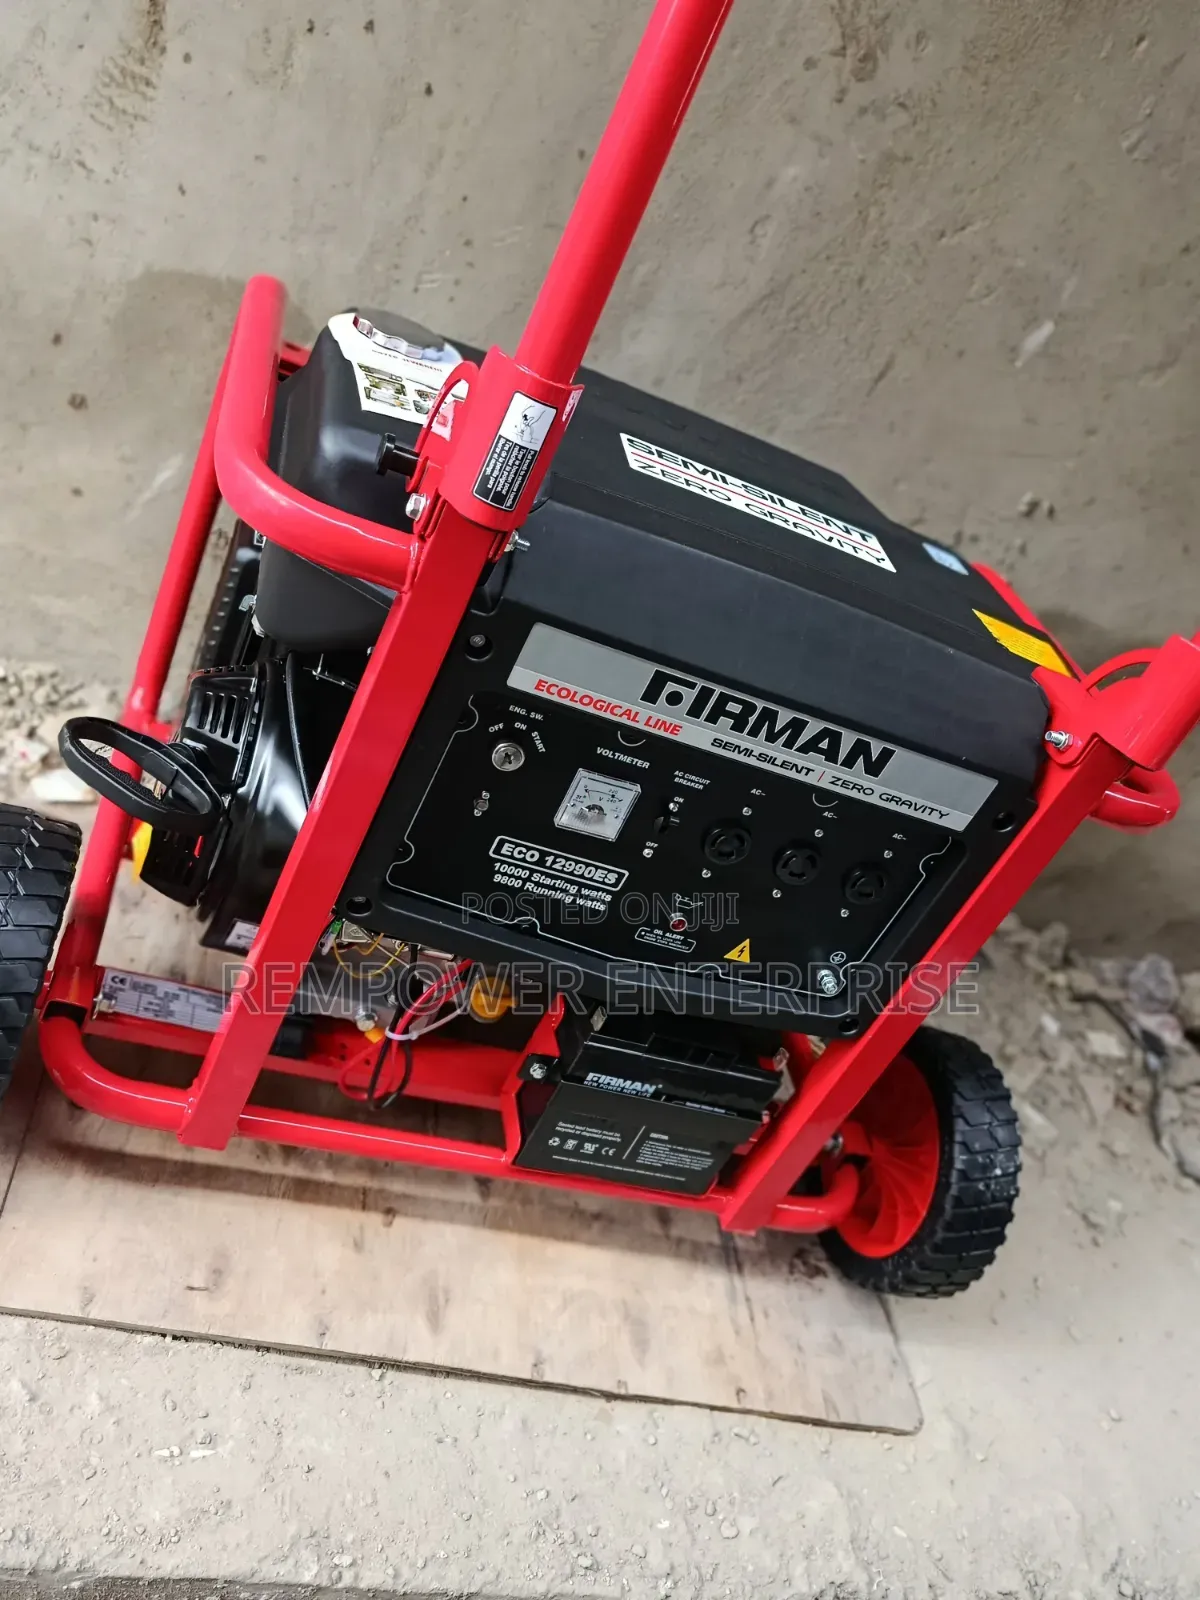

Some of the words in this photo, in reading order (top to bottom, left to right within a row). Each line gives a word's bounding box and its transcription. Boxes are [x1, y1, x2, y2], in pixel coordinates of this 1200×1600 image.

[506, 465, 518, 482] bouton
[502, 482, 510, 496] pour
[626, 437, 877, 543] SEMI-SILENT
[634, 458, 731, 502] ZERO
[744, 502, 886, 564] GRAVITY
[509, 704, 528, 716] ENG.
[530, 712, 544, 721] SW.
[534, 678, 641, 725] ECOLOGICAL
[643, 711, 683, 736] LINE
[488, 722, 504, 732] OFF
[514, 722, 528, 731] ON
[638, 668, 896, 779] FIRMAN
[531, 731, 546, 753] START
[596, 746, 650, 769] VOLTMETER
[674, 777, 704, 790] BREAKER
[684, 774, 710, 784] CIRCUIT
[710, 737, 815, 778] SEMI-SILENT
[828, 775, 875, 798] ZERO
[879, 791, 950, 820] GRAVITY
[500, 842, 540, 862] ECO
[544, 855, 619, 885] 12990ES
[493, 873, 523, 889] 9800
[524, 881, 574, 904] Running
[576, 896, 606, 911] watts
[494, 862, 530, 879] 10000
[531, 872, 578, 895] Starting
[581, 887, 612, 902] watts
[664, 932, 684, 940] ALERT
[586, 1072, 656, 1094] FIRMAN
[600, 1084, 622, 1092] POWER
